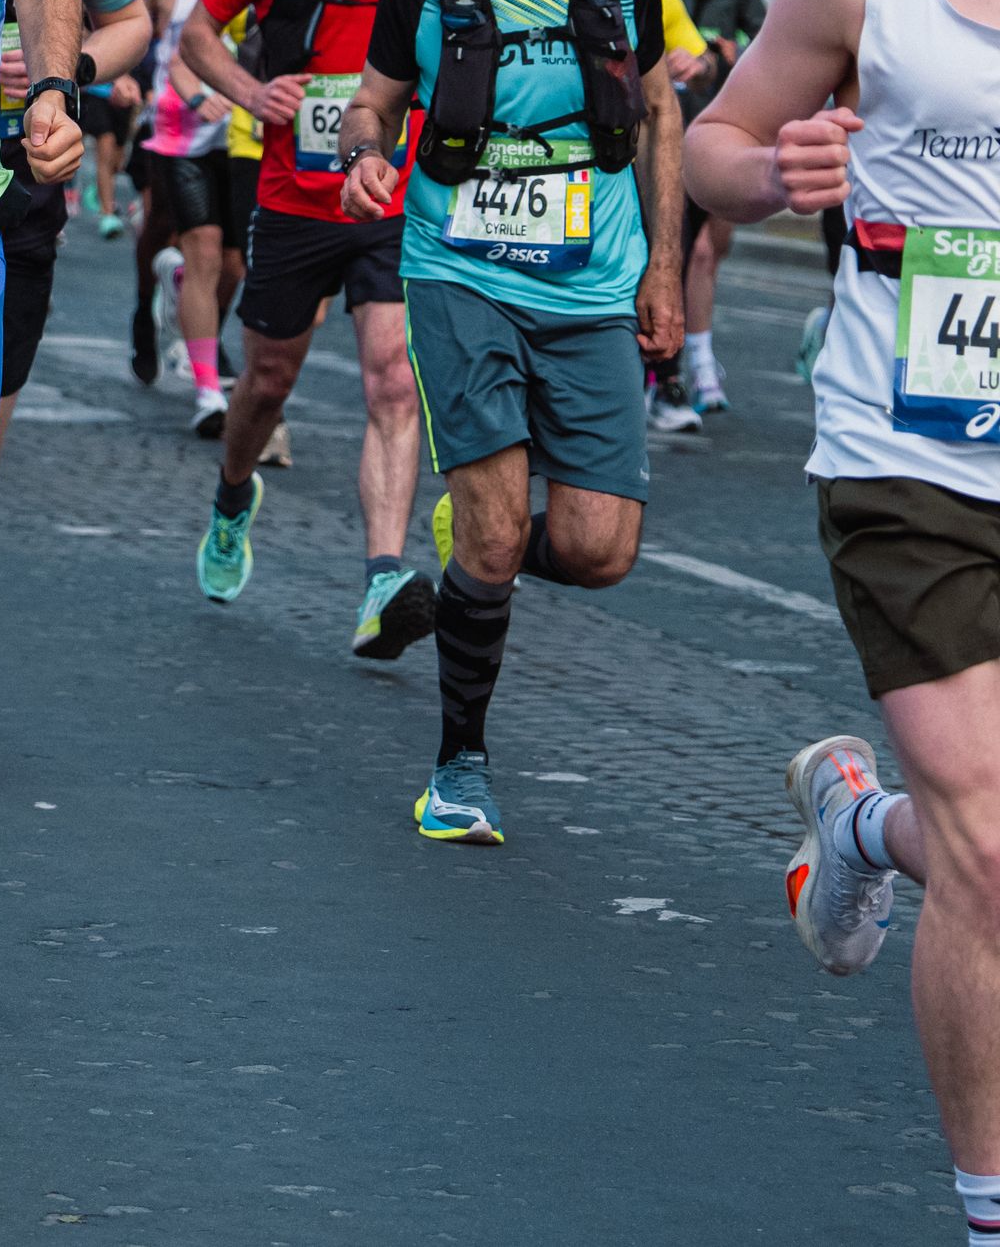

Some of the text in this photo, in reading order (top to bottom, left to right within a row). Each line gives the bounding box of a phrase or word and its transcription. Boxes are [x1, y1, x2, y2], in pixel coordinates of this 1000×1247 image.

[487, 140, 548, 156] hneide
[914, 128, 994, 160] Team
[472, 177, 548, 218] 4476
[485, 222, 527, 237] CYRILLE
[937, 293, 1000, 359] 44
